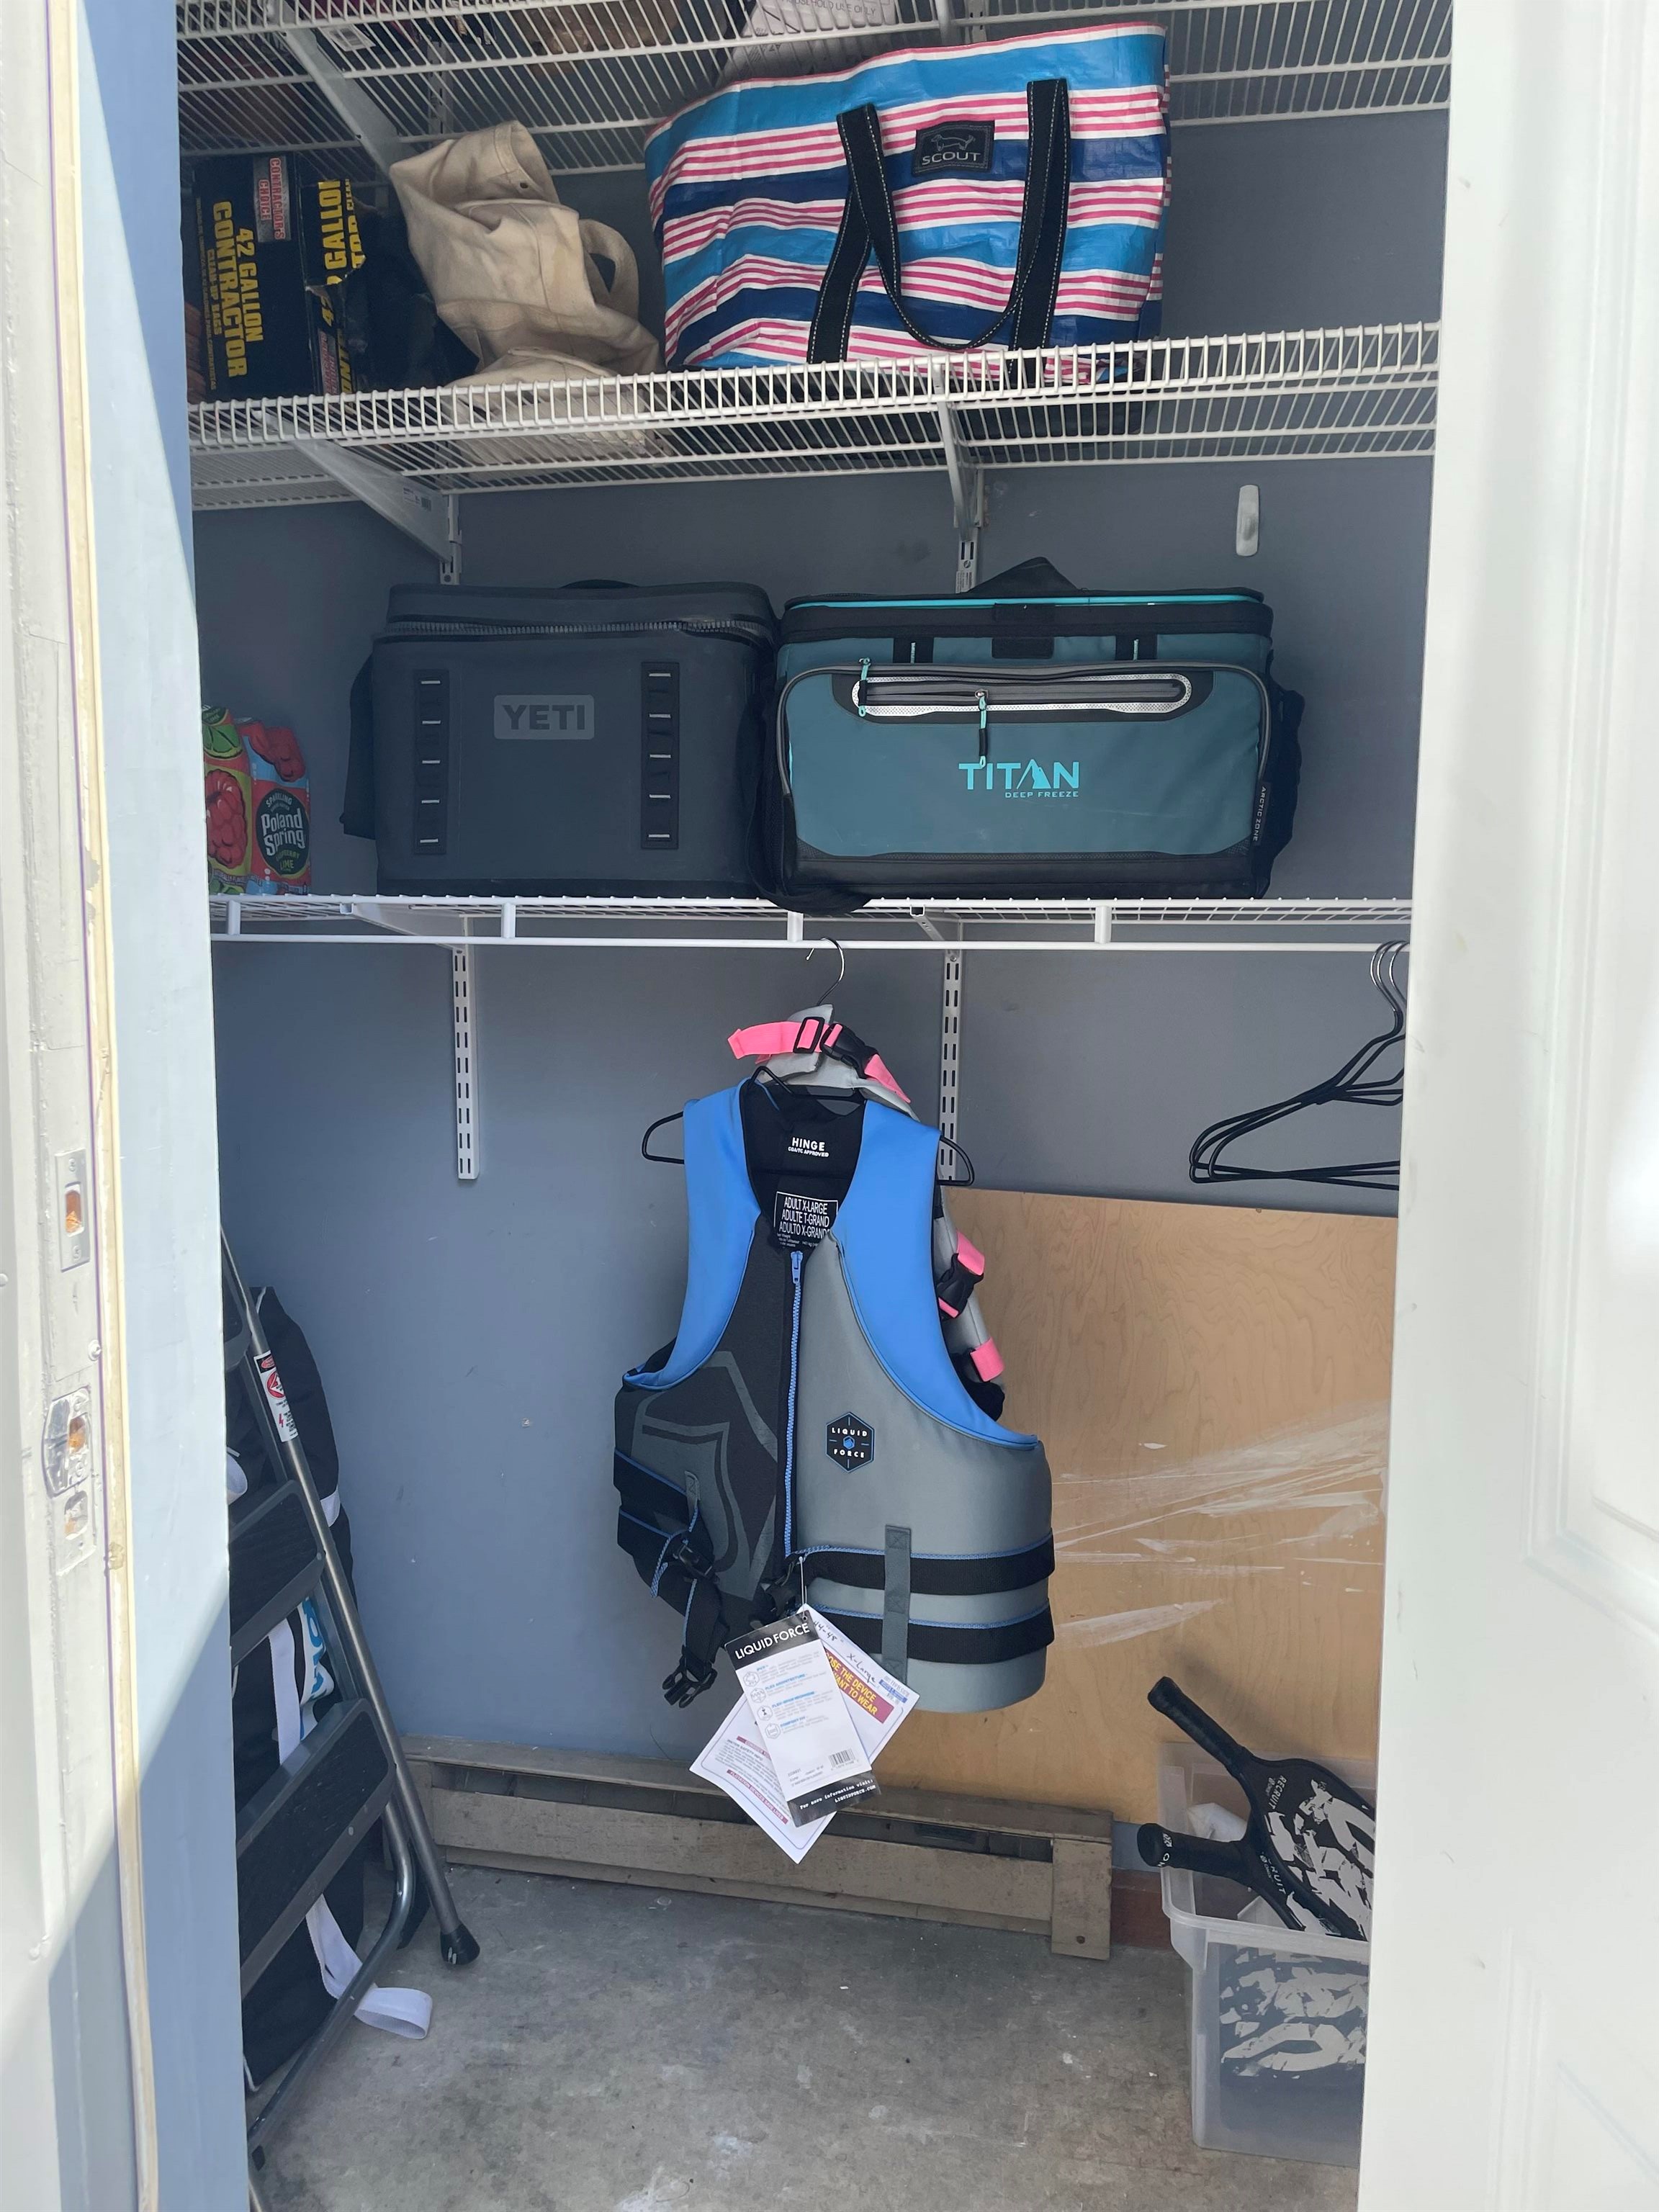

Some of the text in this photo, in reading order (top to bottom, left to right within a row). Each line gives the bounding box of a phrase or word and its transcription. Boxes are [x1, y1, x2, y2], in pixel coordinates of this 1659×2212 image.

[782, 0, 834, 9] USEHOLD
[922, 151, 981, 165] SCOUT
[259, 179, 271, 220] CHOICE
[269, 157, 285, 240] CONTRACTOR'S
[213, 201, 247, 377] CONTRACTOR
[236, 228, 264, 342] 42 GALLON
[502, 704, 585, 730] YETI
[958, 759, 1079, 790] TITAN
[1257, 786, 1267, 817] ARCTIC
[261, 808, 303, 836] Poland
[264, 828, 305, 855] Spring
[792, 1137, 825, 1151] HINGE
[782, 1209, 830, 1228] ADULTE T-GRAND
[784, 1197, 828, 1215] ADULT X-LARGE
[779, 1221, 801, 1235] ADULTO
[832, 1427, 867, 1437] LIQUID
[834, 1449, 864, 1458] FORCE
[734, 1622, 810, 1660] LIQUID FORCE
[841, 1667, 854, 1681] THE
[853, 1678, 876, 1702] DEVICE
[850, 1684, 858, 1698] TO
[858, 1694, 878, 1714] WEAR
[824, 1786, 855, 1799] information
[1268, 1775, 1287, 1809] RECRUIT
